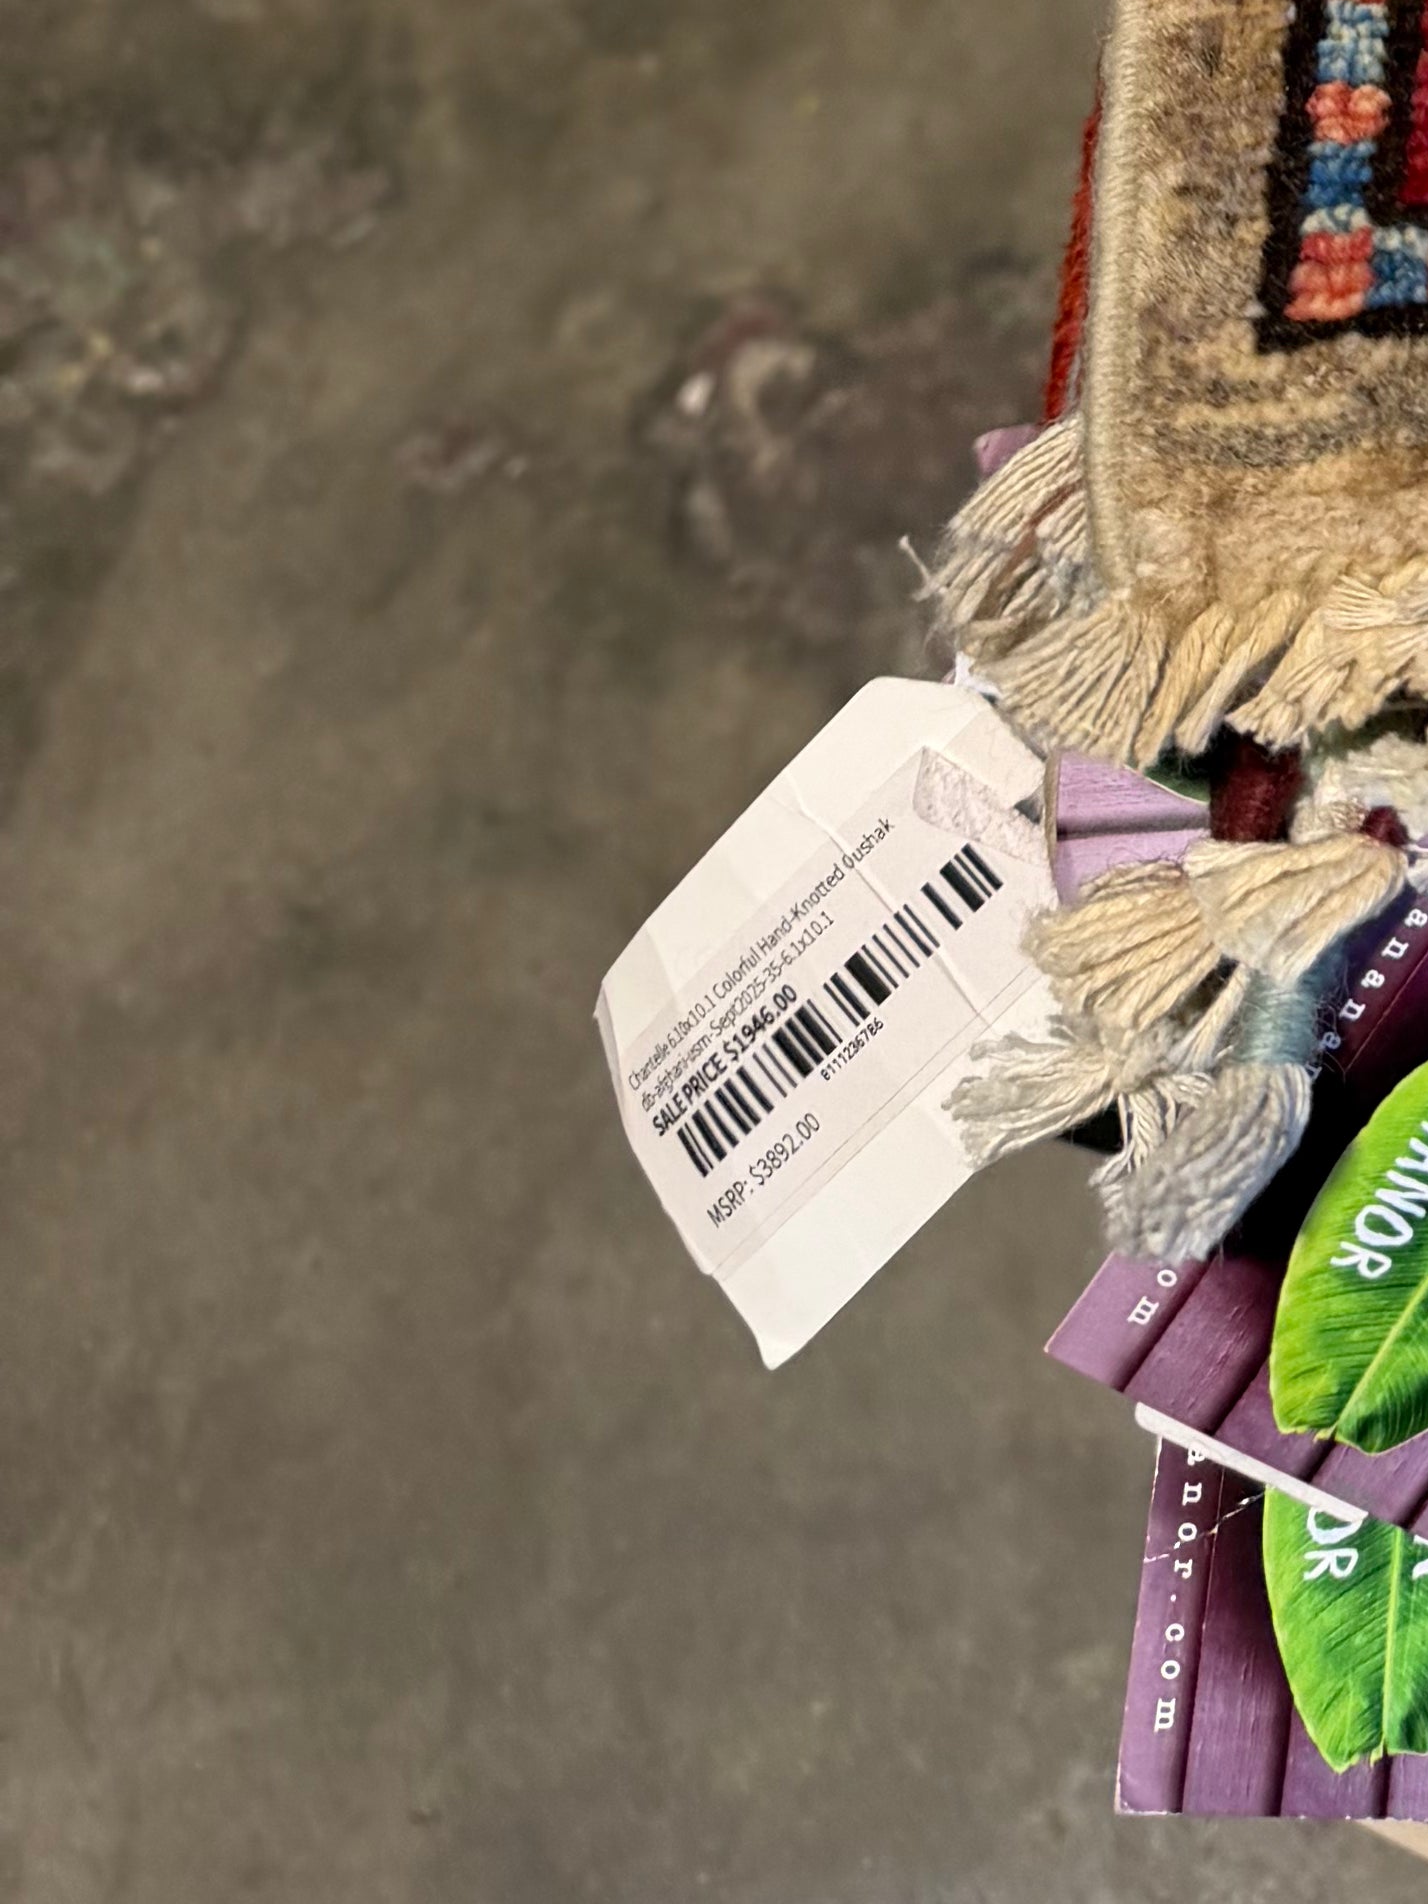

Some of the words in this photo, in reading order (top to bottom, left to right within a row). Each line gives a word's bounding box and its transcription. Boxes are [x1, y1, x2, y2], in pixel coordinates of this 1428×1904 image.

[630, 1043, 669, 1090] Chantelle
[712, 946, 761, 1000] Colorful
[757, 863, 844, 957] Hand-Knotted
[842, 817, 895, 869] Oushak
[652, 1096, 688, 1136] SALE
[682, 1052, 728, 1105] PRICE
[723, 984, 797, 1062] $1946.00
[706, 1180, 754, 1228] MSRP:
[750, 1112, 820, 1186] $3892.00
